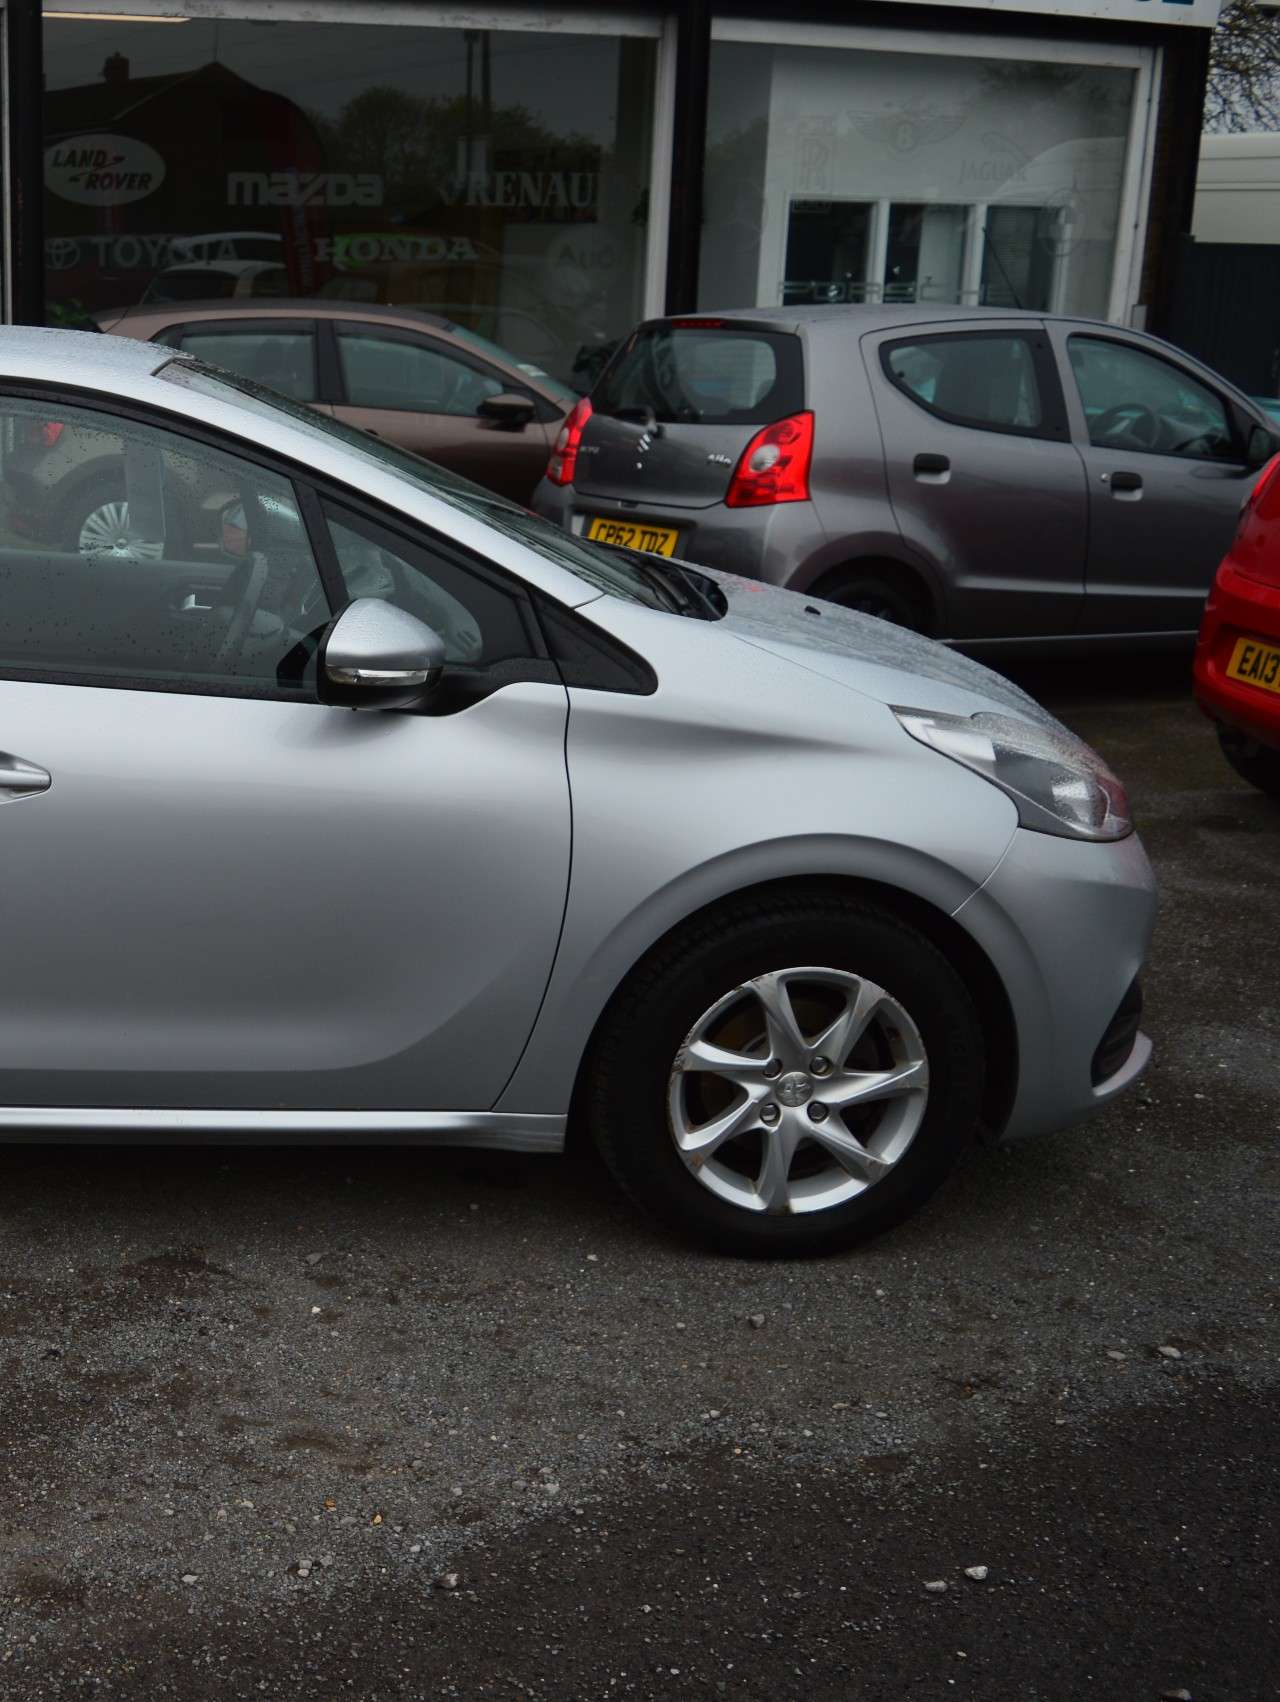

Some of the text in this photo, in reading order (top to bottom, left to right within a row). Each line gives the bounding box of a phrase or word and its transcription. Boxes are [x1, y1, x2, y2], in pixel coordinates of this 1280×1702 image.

[53, 150, 106, 168] LAND
[85, 172, 153, 191] ROVER
[91, 235, 239, 269] TOYOTA
[314, 235, 480, 264] HONDA
[639, 529, 670, 555] TDZ
[1237, 645, 1279, 684] EA13
